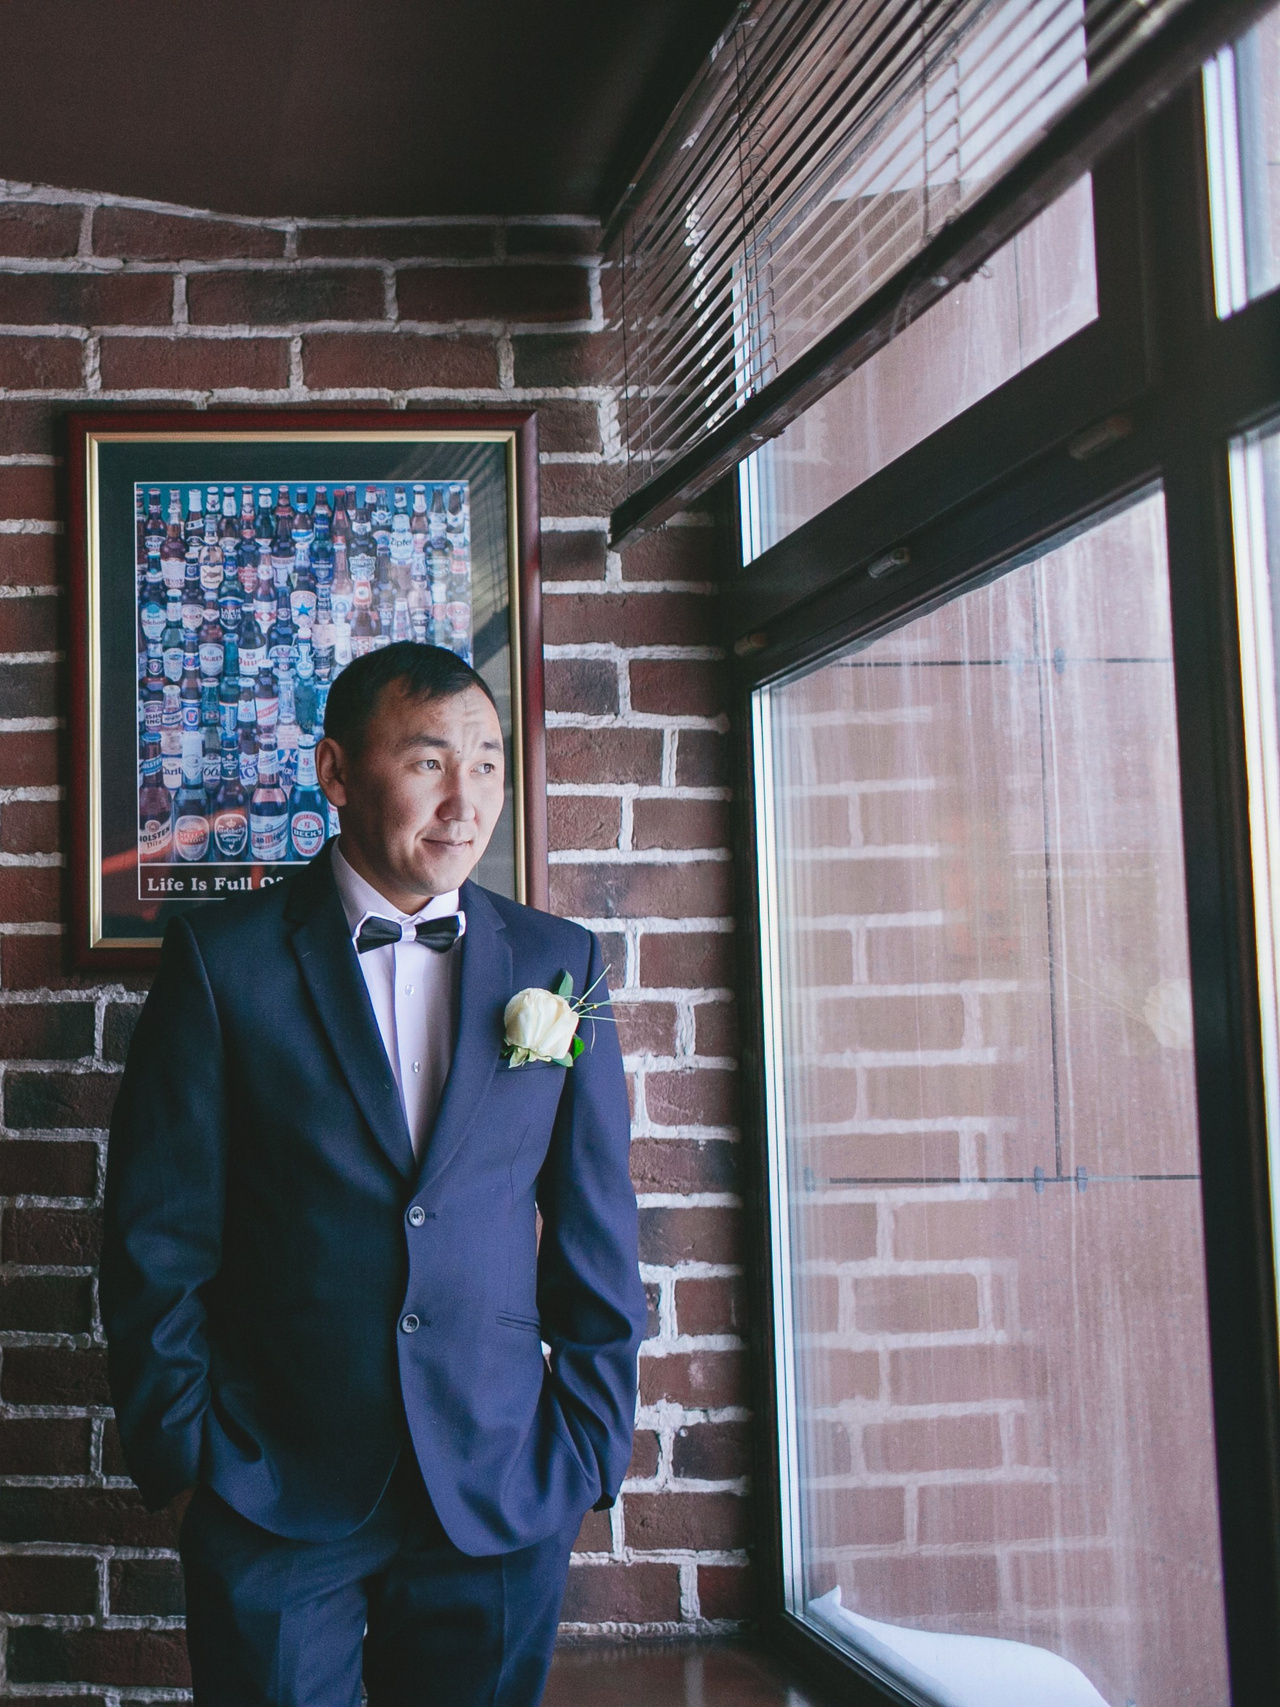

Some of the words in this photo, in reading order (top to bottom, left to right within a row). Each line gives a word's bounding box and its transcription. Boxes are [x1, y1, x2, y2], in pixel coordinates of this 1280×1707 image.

[216, 824, 245, 834] Carlsberg
[147, 877, 184, 891] Life
[191, 877, 207, 891] Is
[214, 876, 253, 891] Full
